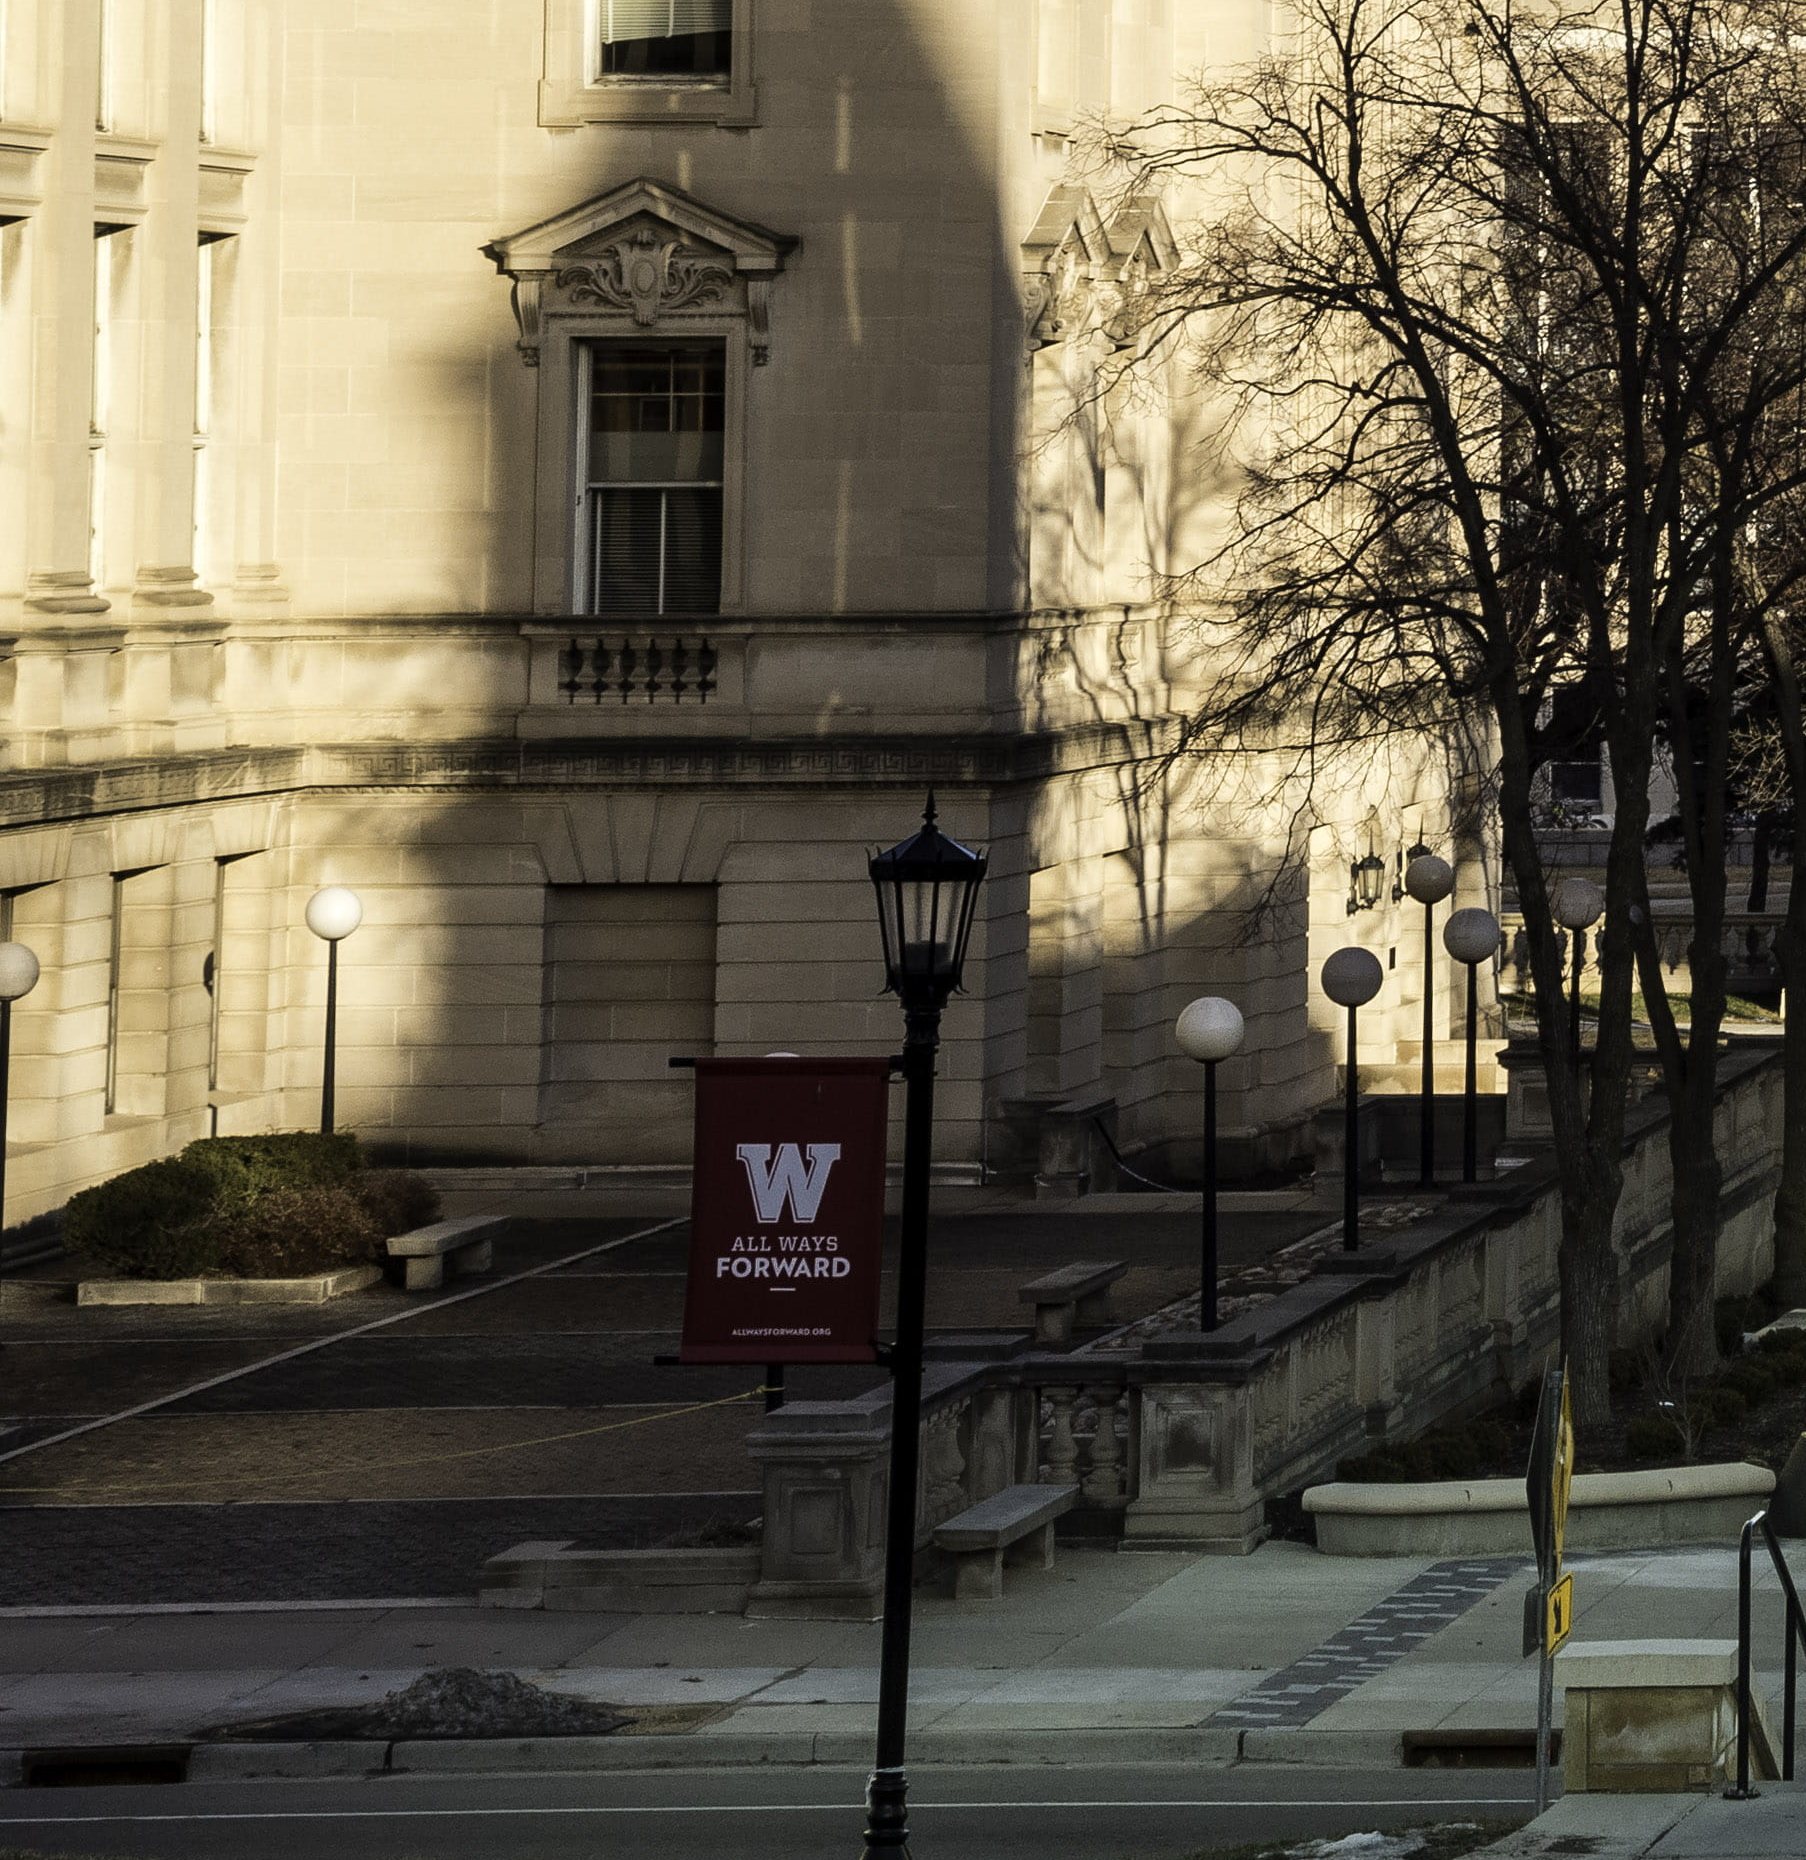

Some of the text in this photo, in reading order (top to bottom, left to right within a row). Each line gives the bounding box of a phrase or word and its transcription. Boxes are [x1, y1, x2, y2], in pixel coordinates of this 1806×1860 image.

[735, 1143, 842, 1224] W
[731, 1236, 838, 1252] ALL WAYS
[716, 1257, 851, 1278] FORWARD
[731, 1327, 832, 1336] ALLWAYSFORWARD.ORG
